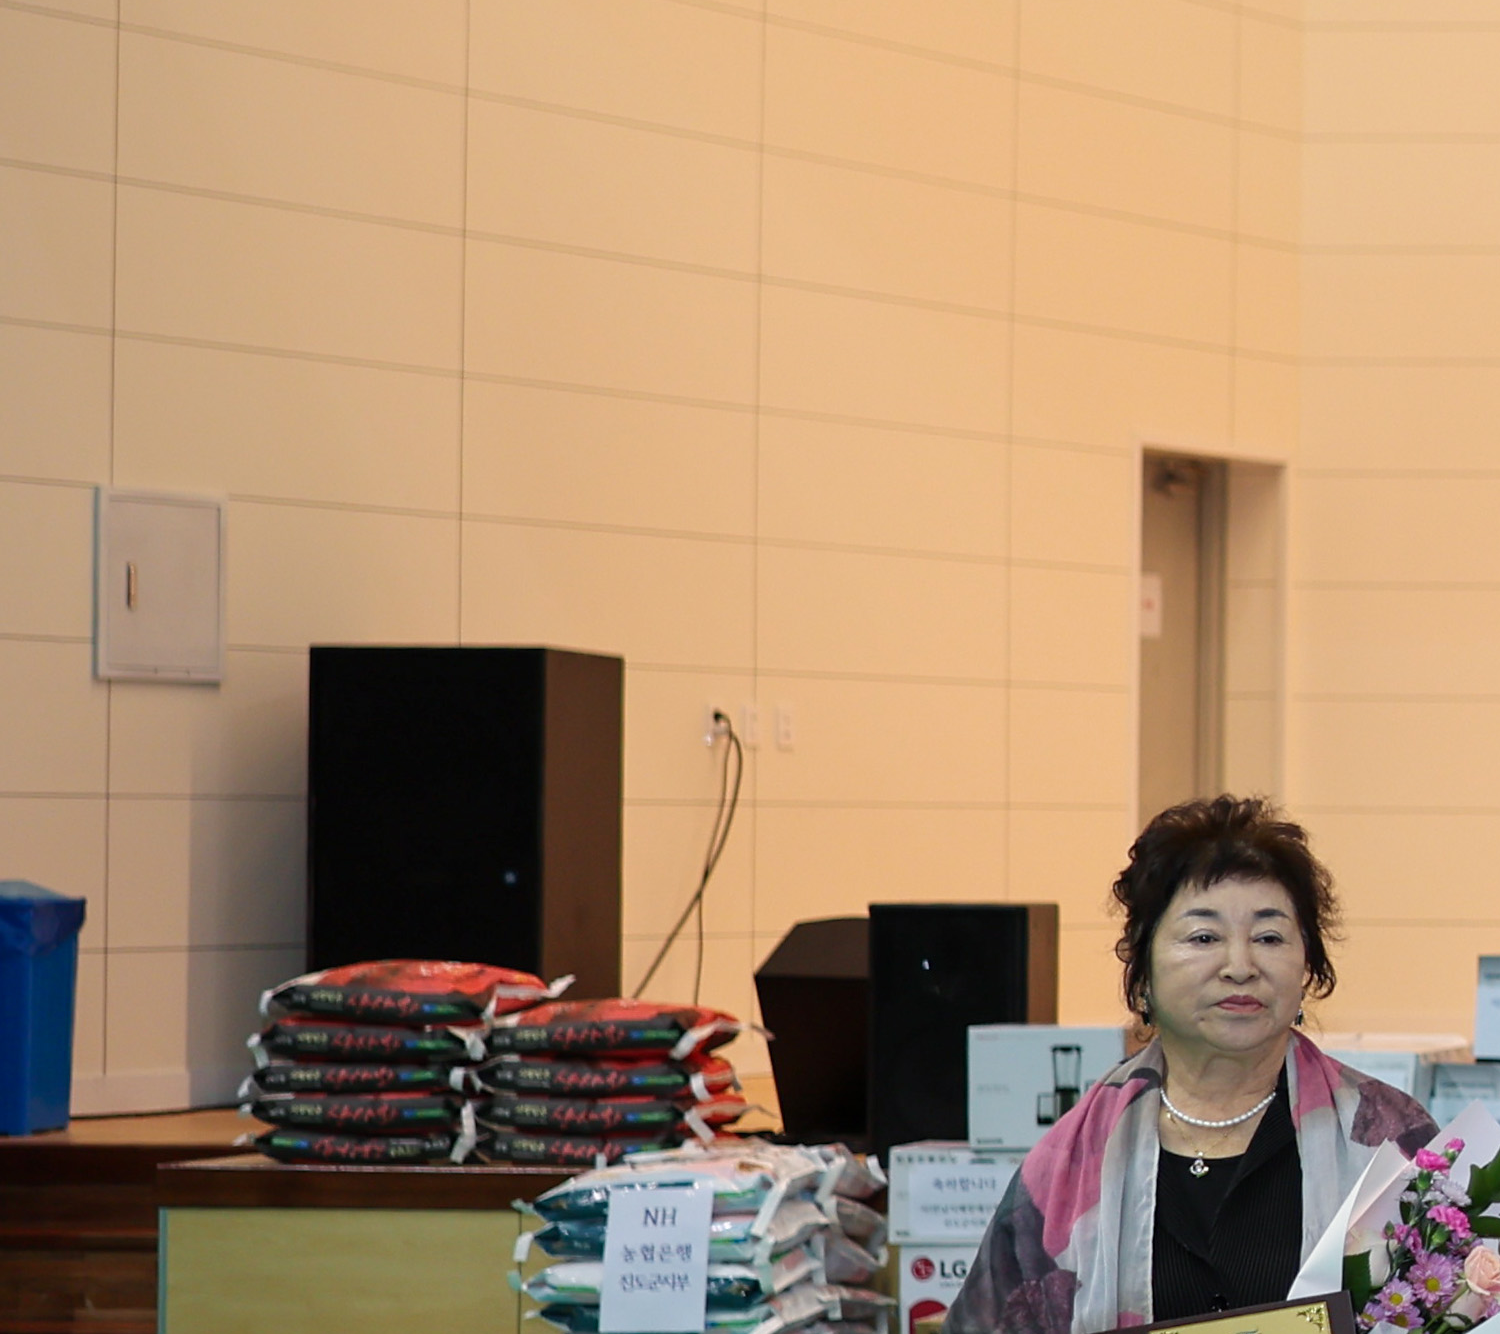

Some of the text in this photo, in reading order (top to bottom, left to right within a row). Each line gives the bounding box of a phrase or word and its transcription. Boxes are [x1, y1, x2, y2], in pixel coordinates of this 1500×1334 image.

[642, 1206, 677, 1228] NH
[622, 1243, 693, 1263] 농협은행
[939, 1260, 967, 1278] LG
